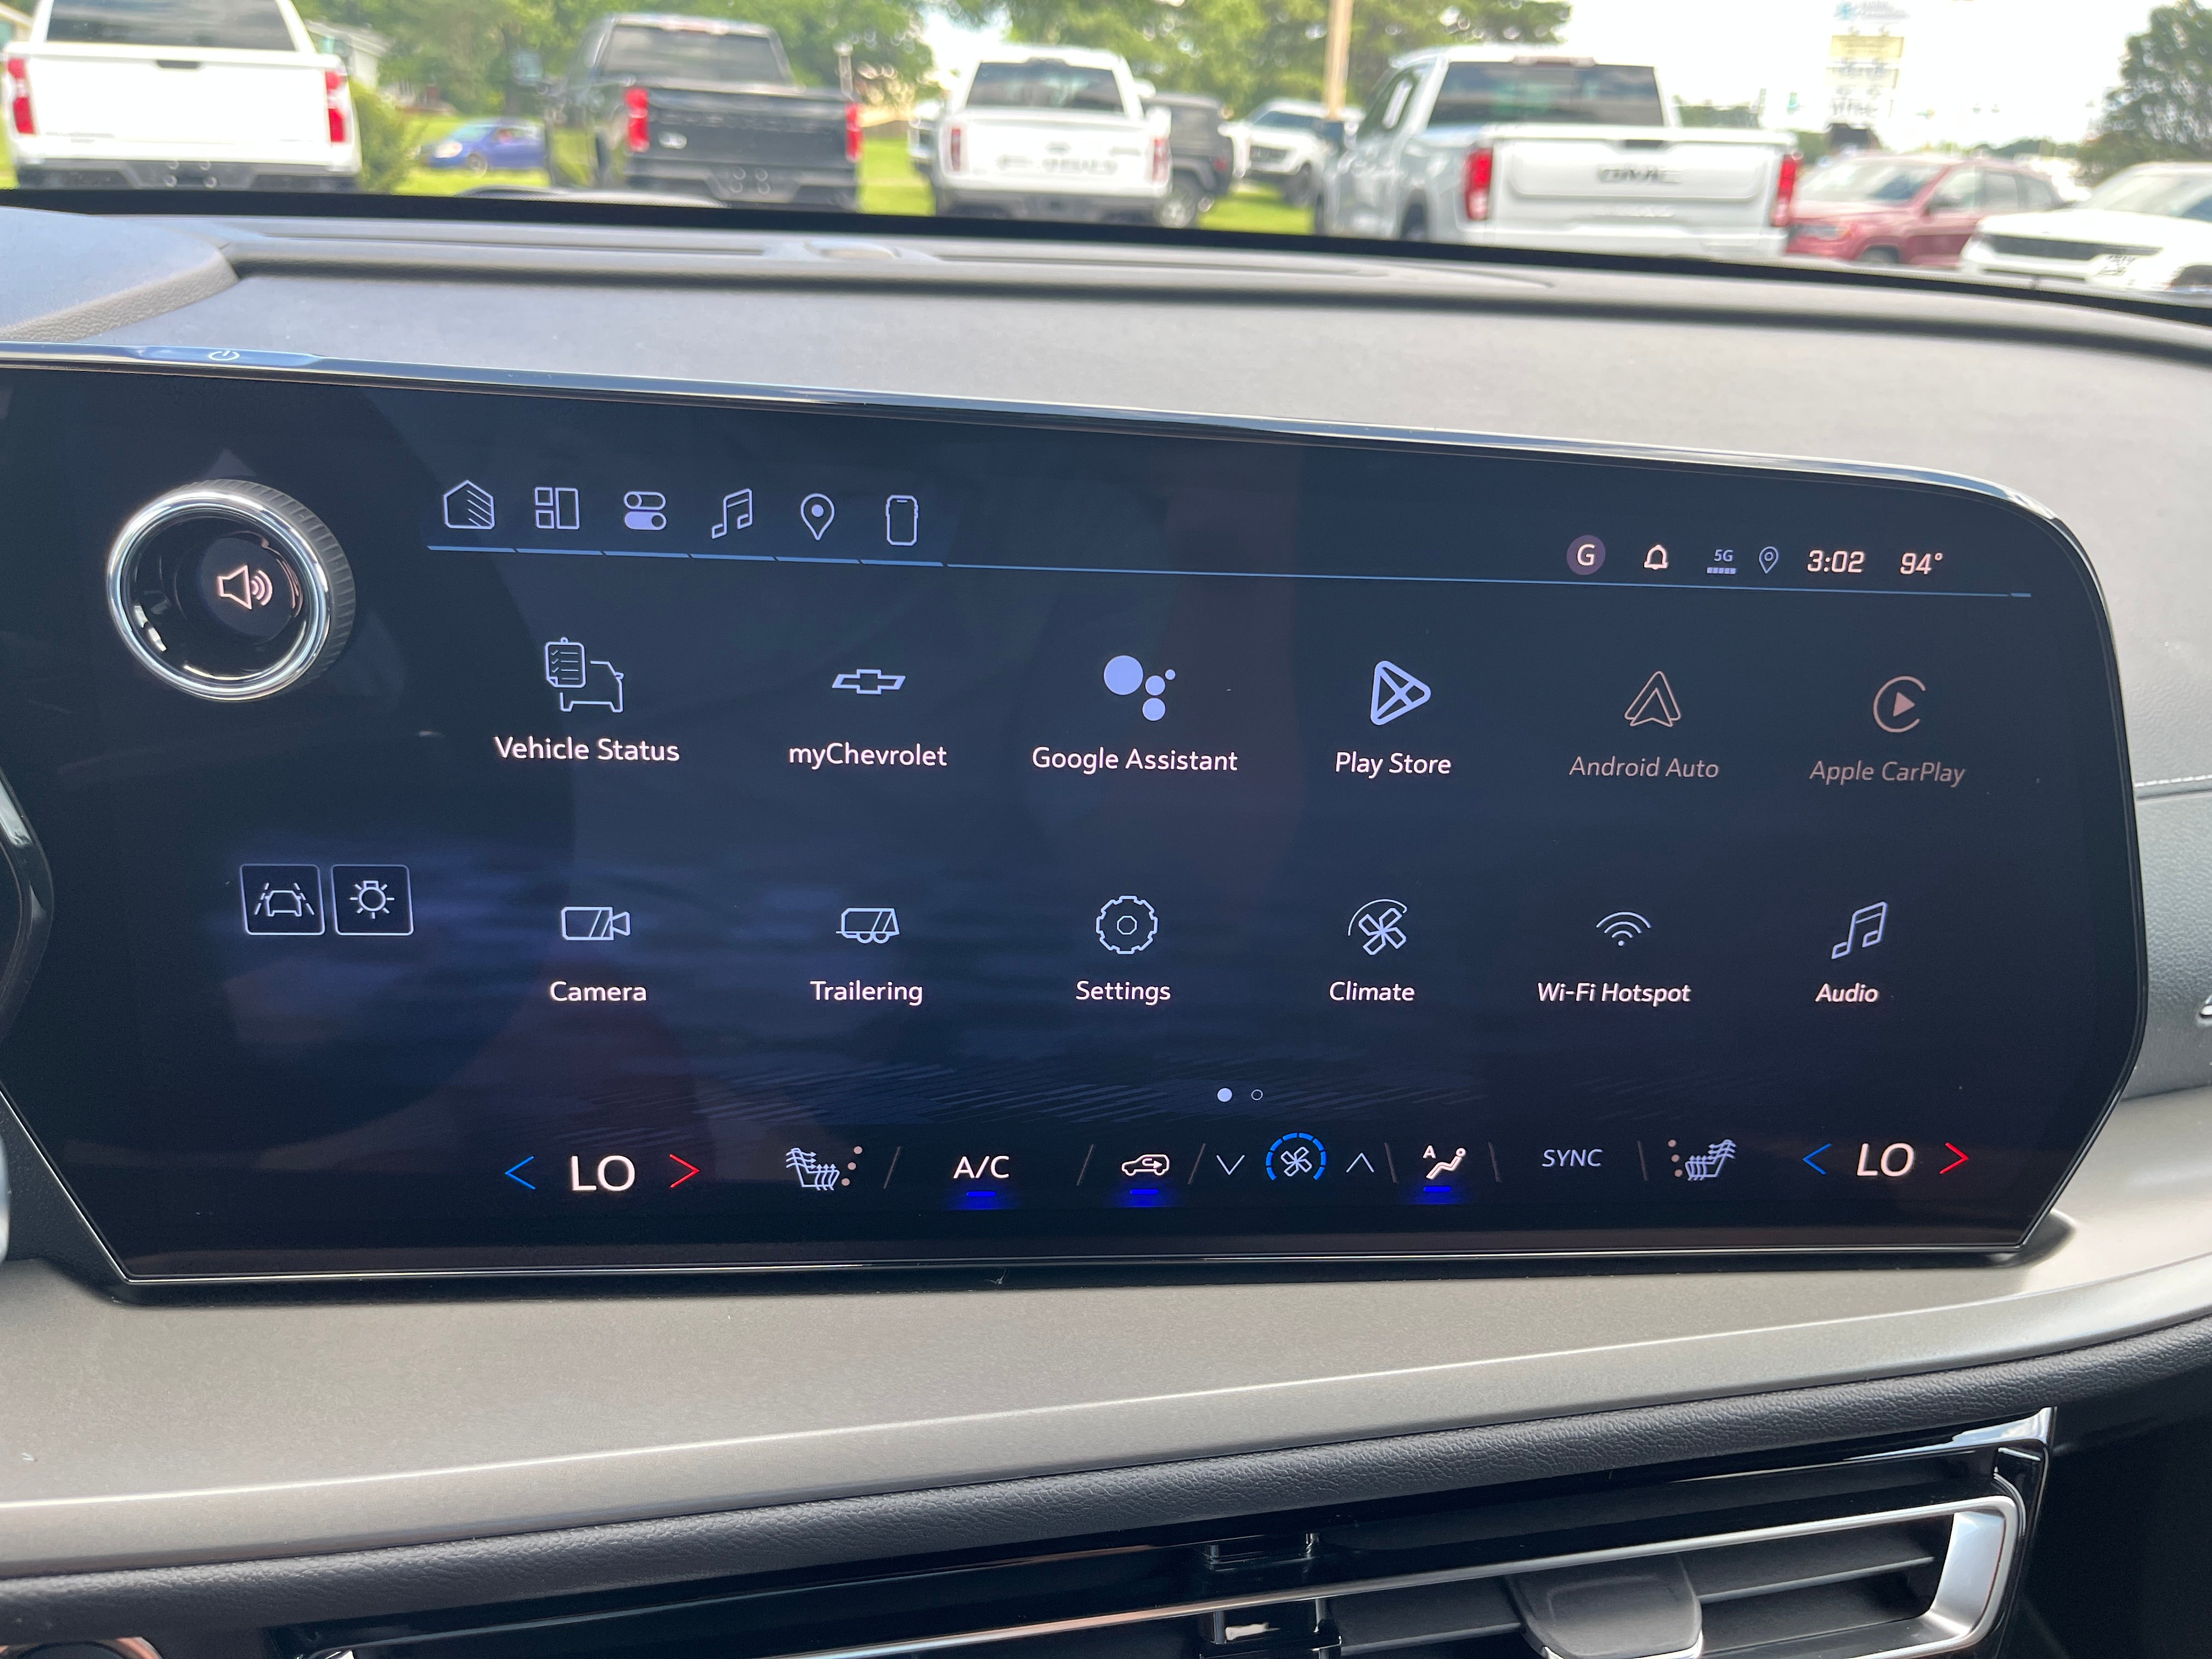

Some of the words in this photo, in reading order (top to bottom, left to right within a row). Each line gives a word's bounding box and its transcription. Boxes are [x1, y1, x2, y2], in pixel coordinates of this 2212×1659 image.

[1577, 544, 1595, 566] G
[1713, 549, 1733, 562] 5G
[1807, 550, 1865, 573] 3:02
[494, 735, 589, 760] Vehicle
[597, 738, 680, 761] Status
[789, 742, 947, 770] myChevrolet
[1032, 746, 1119, 775] Google
[1125, 748, 1238, 771] Assistant
[1335, 751, 1384, 779] Play
[1389, 752, 1452, 774] Store
[1568, 755, 1660, 777] Android
[1665, 758, 1719, 778] Auto
[1809, 760, 1875, 786] Apple
[1882, 761, 1966, 788] CarPlay
[550, 981, 647, 1002] Camera
[810, 979, 923, 1006] Trailering
[1075, 980, 1171, 1006] Settings
[1329, 980, 1415, 1001] Climate
[1538, 982, 1596, 1002] Wi-Fi
[1601, 983, 1692, 1007] Hotspot
[1815, 982, 1878, 1002] Audio
[1423, 1145, 1436, 1159] A
[1542, 1149, 1602, 1167] SYNC
[1857, 1143, 1915, 1177] LO
[571, 1155, 635, 1192] LO
[953, 1155, 1009, 1179] A/C
